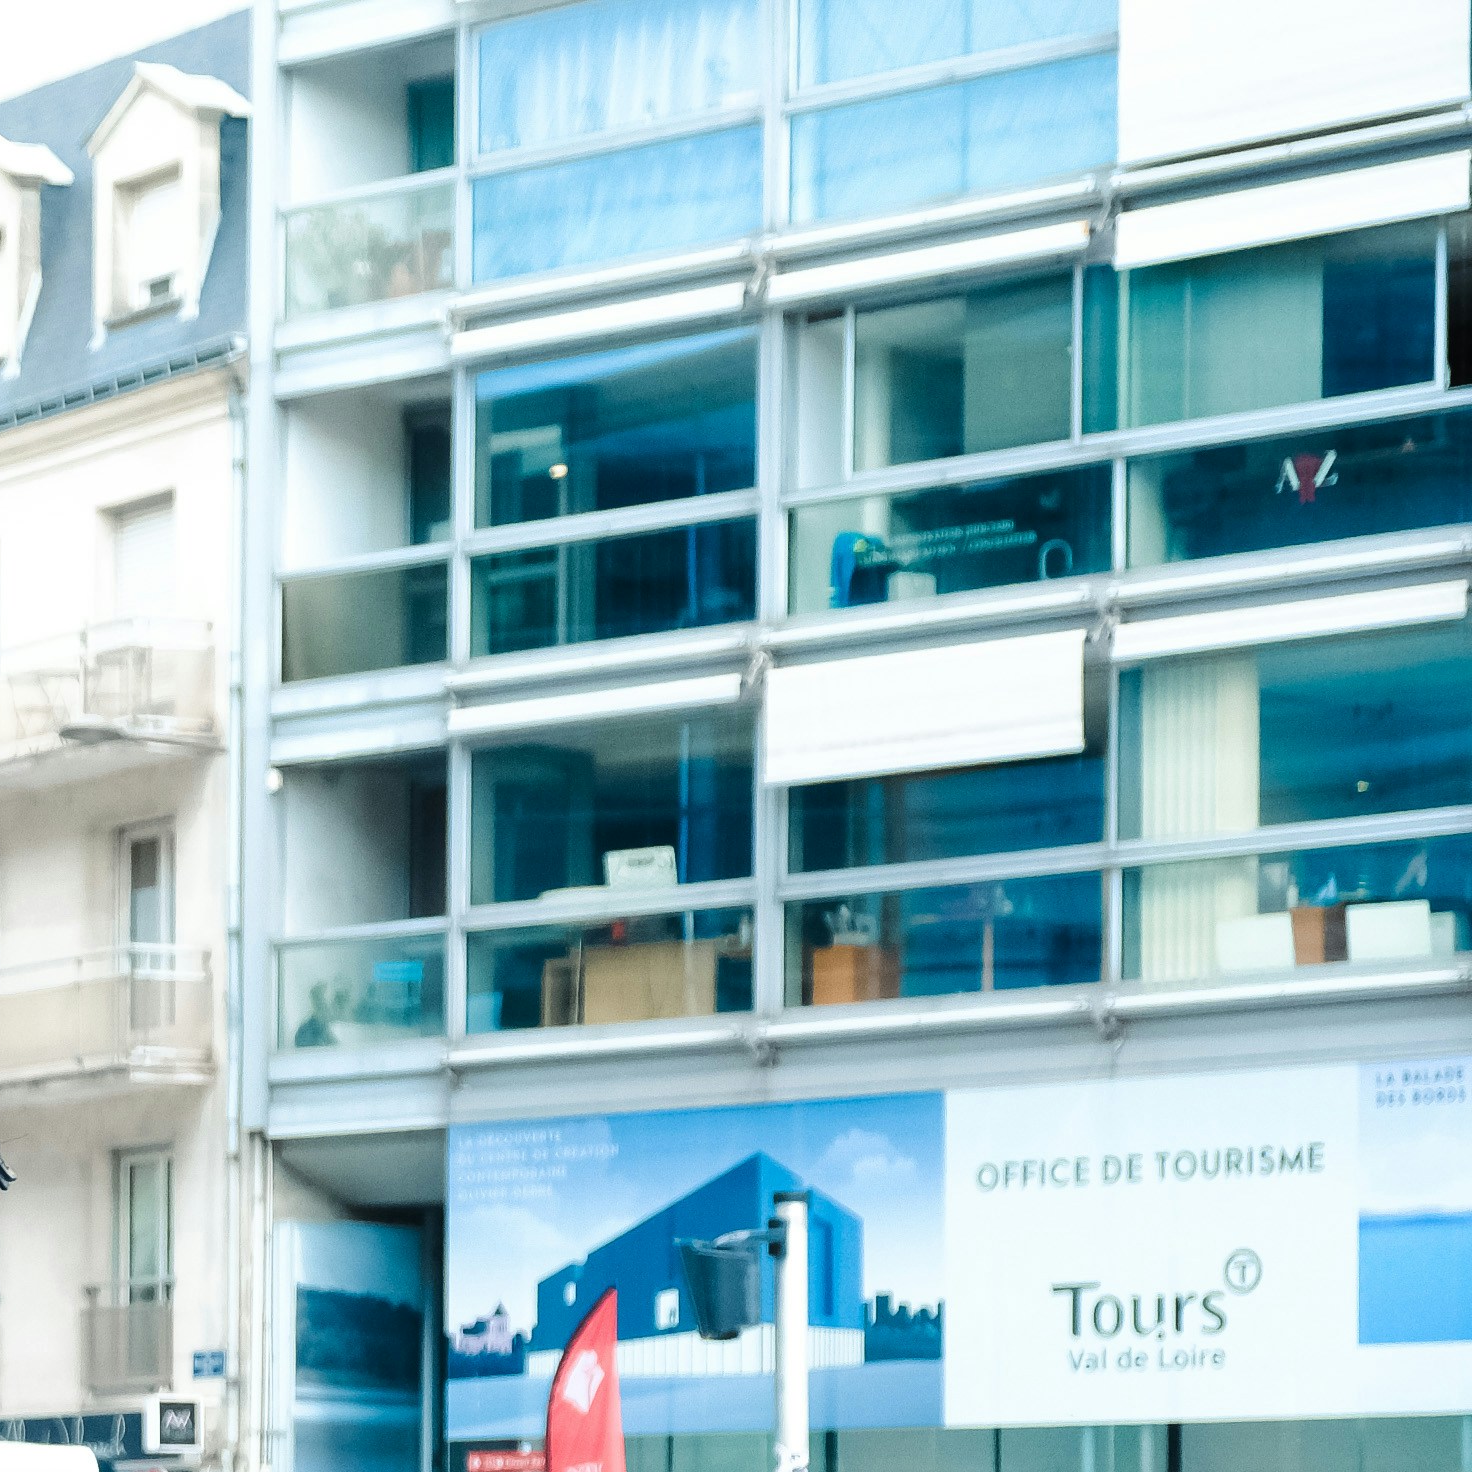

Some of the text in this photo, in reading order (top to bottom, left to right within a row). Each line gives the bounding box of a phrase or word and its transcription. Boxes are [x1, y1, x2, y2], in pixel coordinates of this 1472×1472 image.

[976, 1142, 1326, 1191] OFFICE DE TOURISME
[1051, 1281, 1226, 1340] Tours
[1068, 1344, 1226, 1373] Val de Loire
